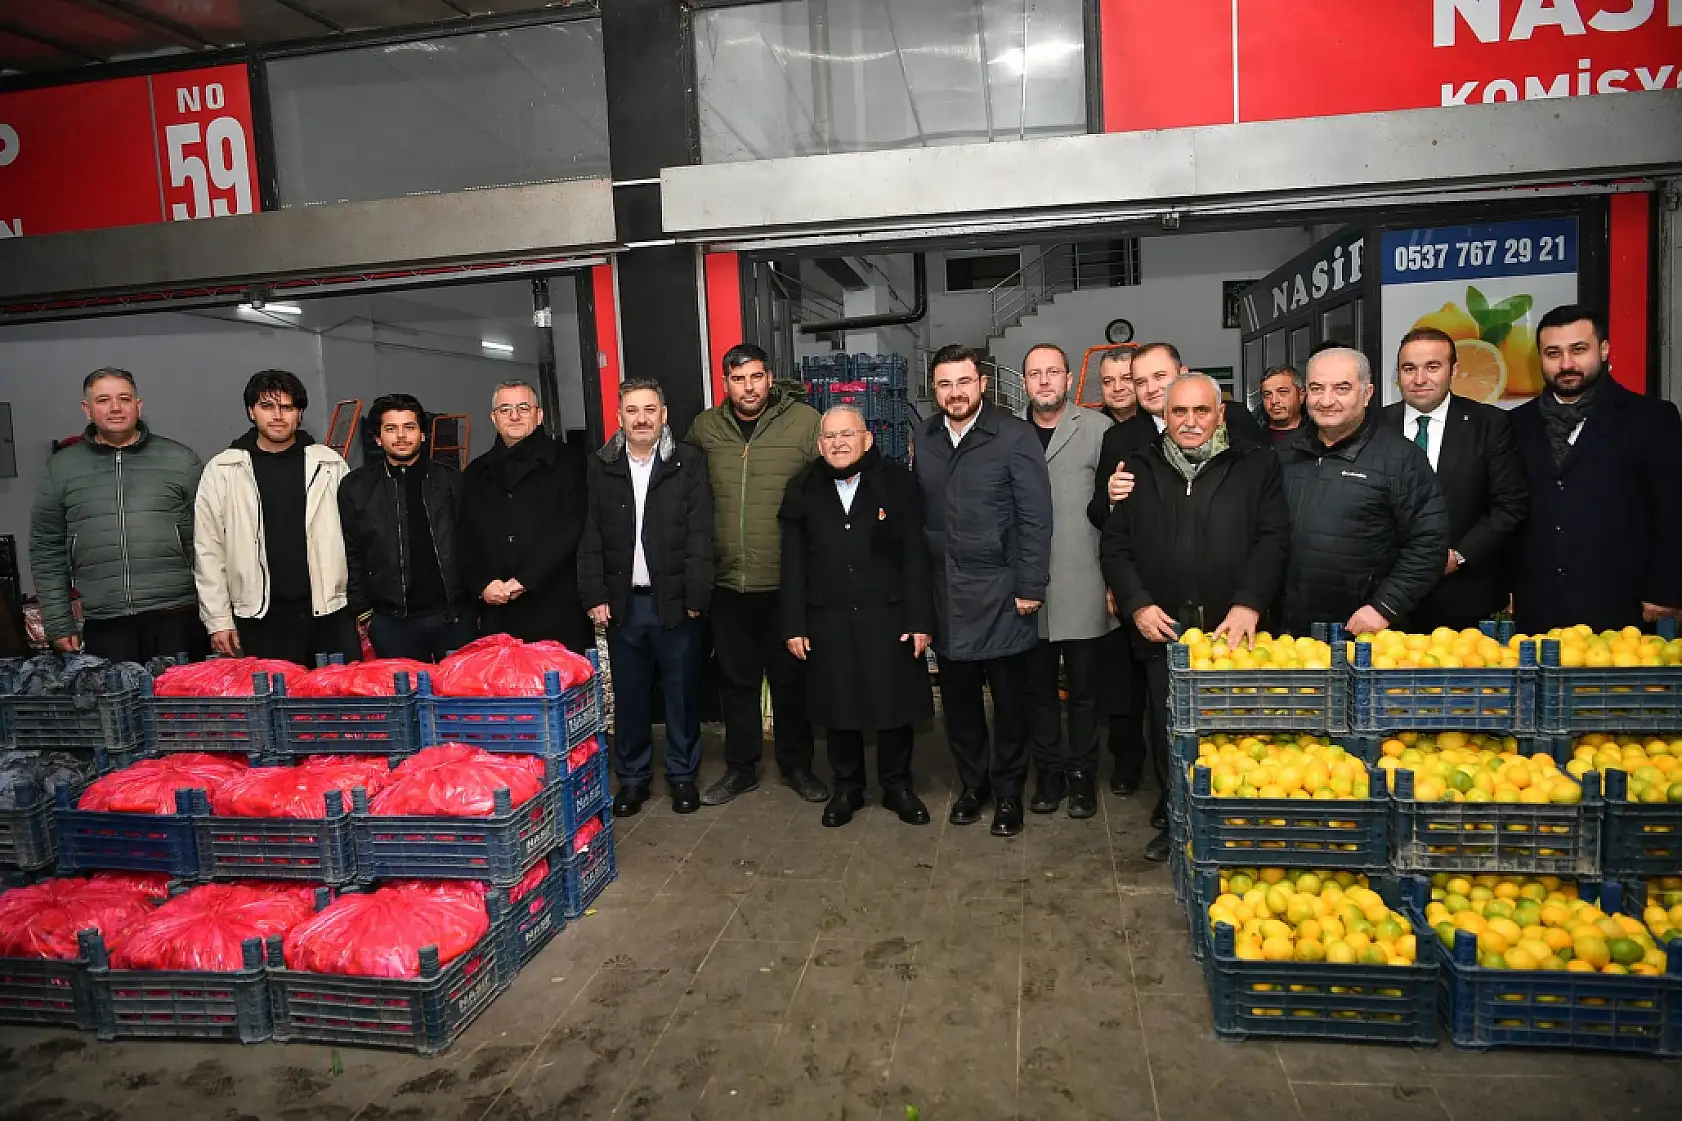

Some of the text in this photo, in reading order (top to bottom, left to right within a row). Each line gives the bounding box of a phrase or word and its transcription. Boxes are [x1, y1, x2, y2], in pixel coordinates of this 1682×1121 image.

[176, 83, 225, 113] NO
[1440, 58, 1682, 107] KOMİSY
[165, 116, 253, 221] 59
[1395, 235, 1565, 271] 0537 767 29 21
